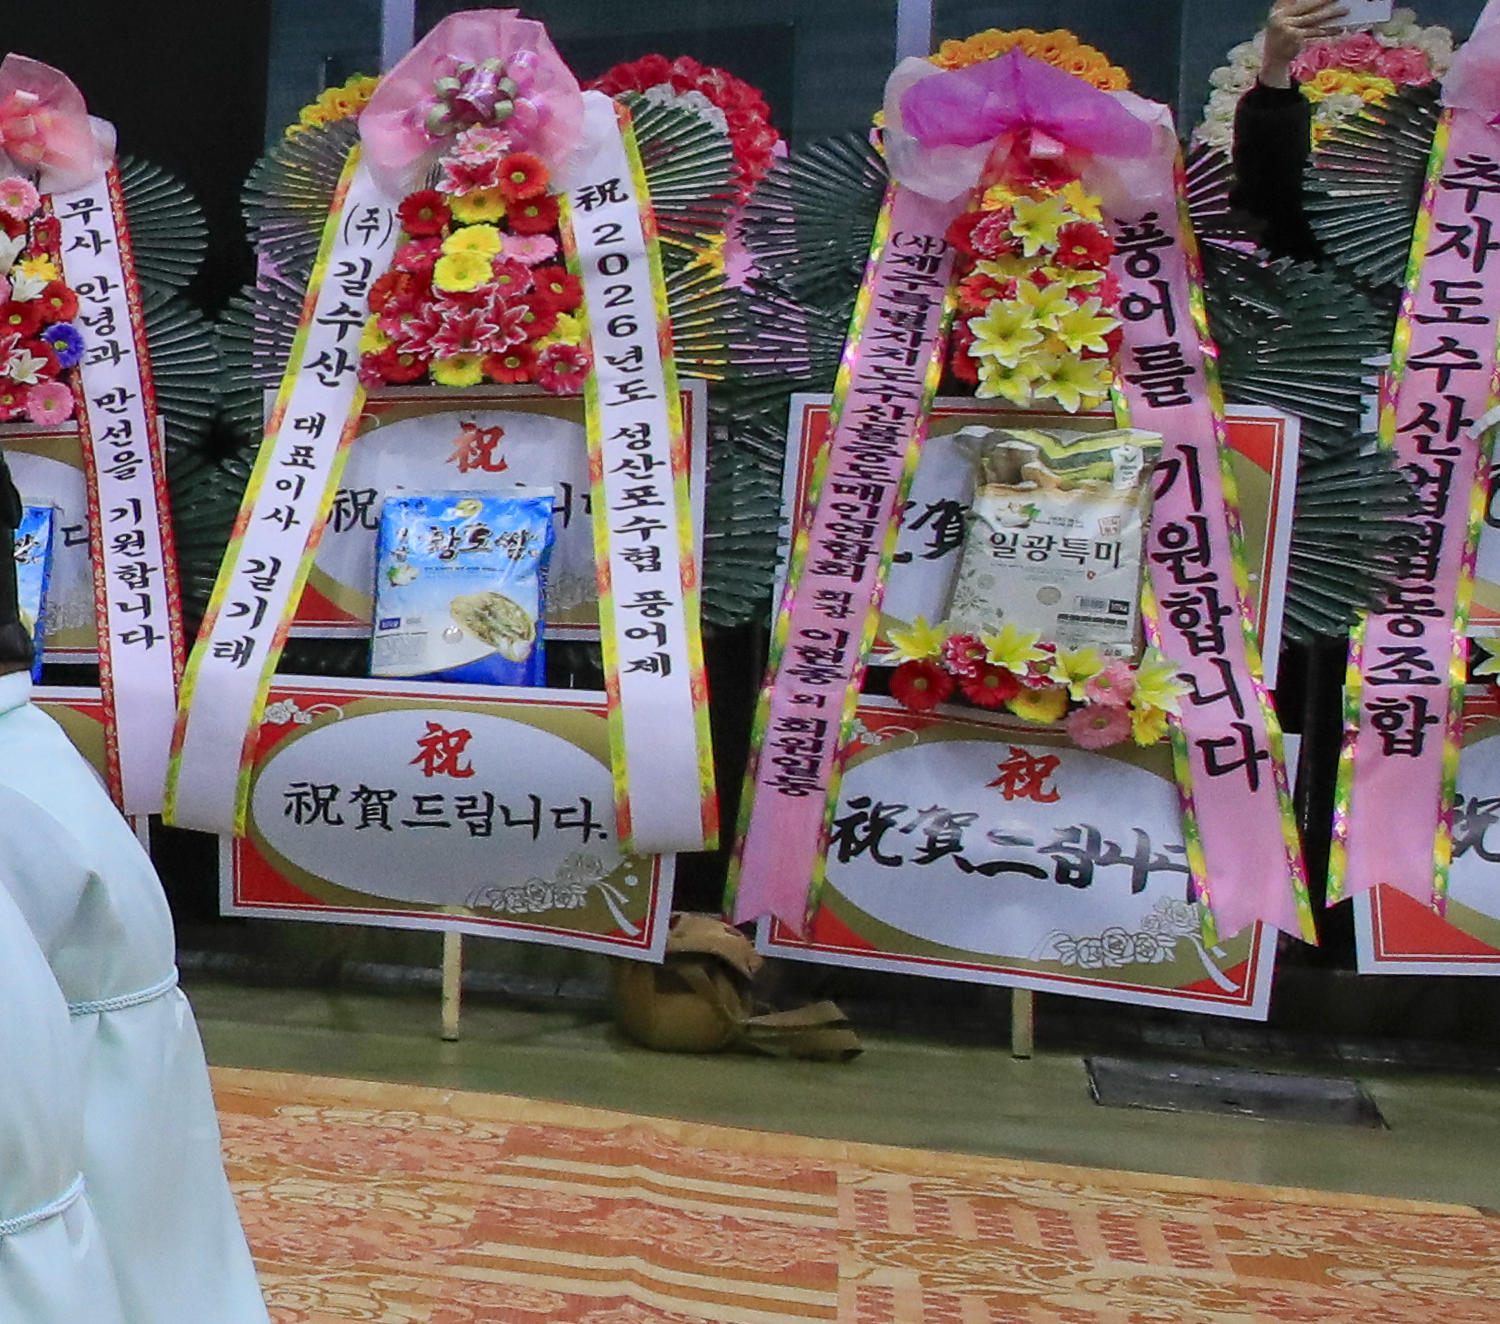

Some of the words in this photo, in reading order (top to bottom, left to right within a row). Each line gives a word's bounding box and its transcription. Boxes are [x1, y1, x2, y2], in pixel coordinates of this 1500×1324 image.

[60, 197, 111, 256] 무사
[573, 177, 629, 213] 祝
[75, 276, 131, 367] 안녕과
[591, 222, 657, 407] 2026년도
[1114, 210, 1197, 409] 풍어를
[92, 386, 145, 481] 만선을
[261, 411, 327, 533] 대표이사
[445, 419, 510, 474] 祝
[607, 421, 668, 575] 성산포수협
[108, 497, 165, 650] 기원합니다
[990, 531, 1122, 569] 일광특미
[212, 555, 283, 669] 길기태
[618, 588, 674, 678] 풍어제
[1152, 443, 1269, 793] 기원합니다
[409, 720, 476, 778] 祝
[984, 745, 1062, 804] 祝
[283, 780, 609, 844] 祝賀드립니다.
